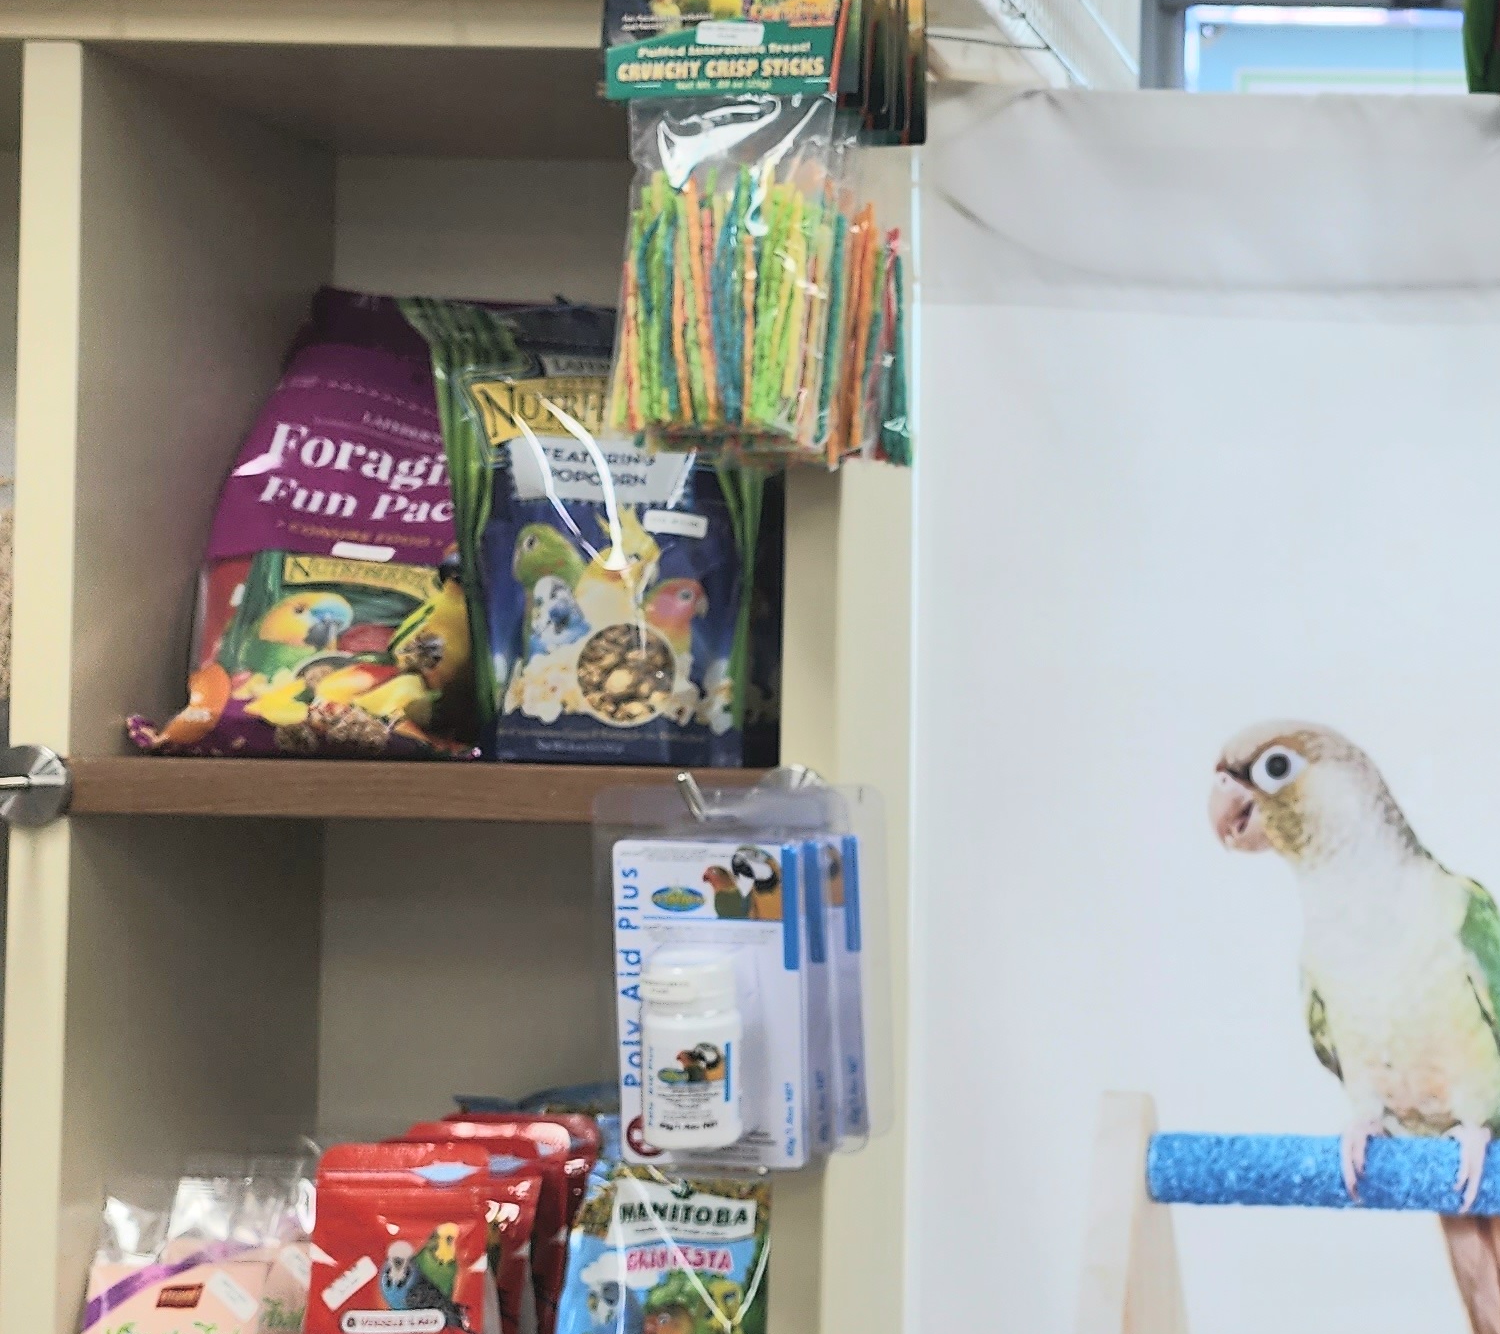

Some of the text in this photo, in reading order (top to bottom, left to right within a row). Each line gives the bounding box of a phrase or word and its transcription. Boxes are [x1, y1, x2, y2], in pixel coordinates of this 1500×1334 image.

[616, 56, 825, 82] CRUNCHY CRISP STICKS
[266, 422, 451, 491] Foragi
[544, 448, 656, 466] FEATRING
[550, 470, 647, 487] POPCRN
[258, 476, 455, 524] Fun Pac
[618, 867, 640, 931] Plus
[620, 948, 642, 1001] Aid
[618, 1201, 749, 1227] MANITOBA
